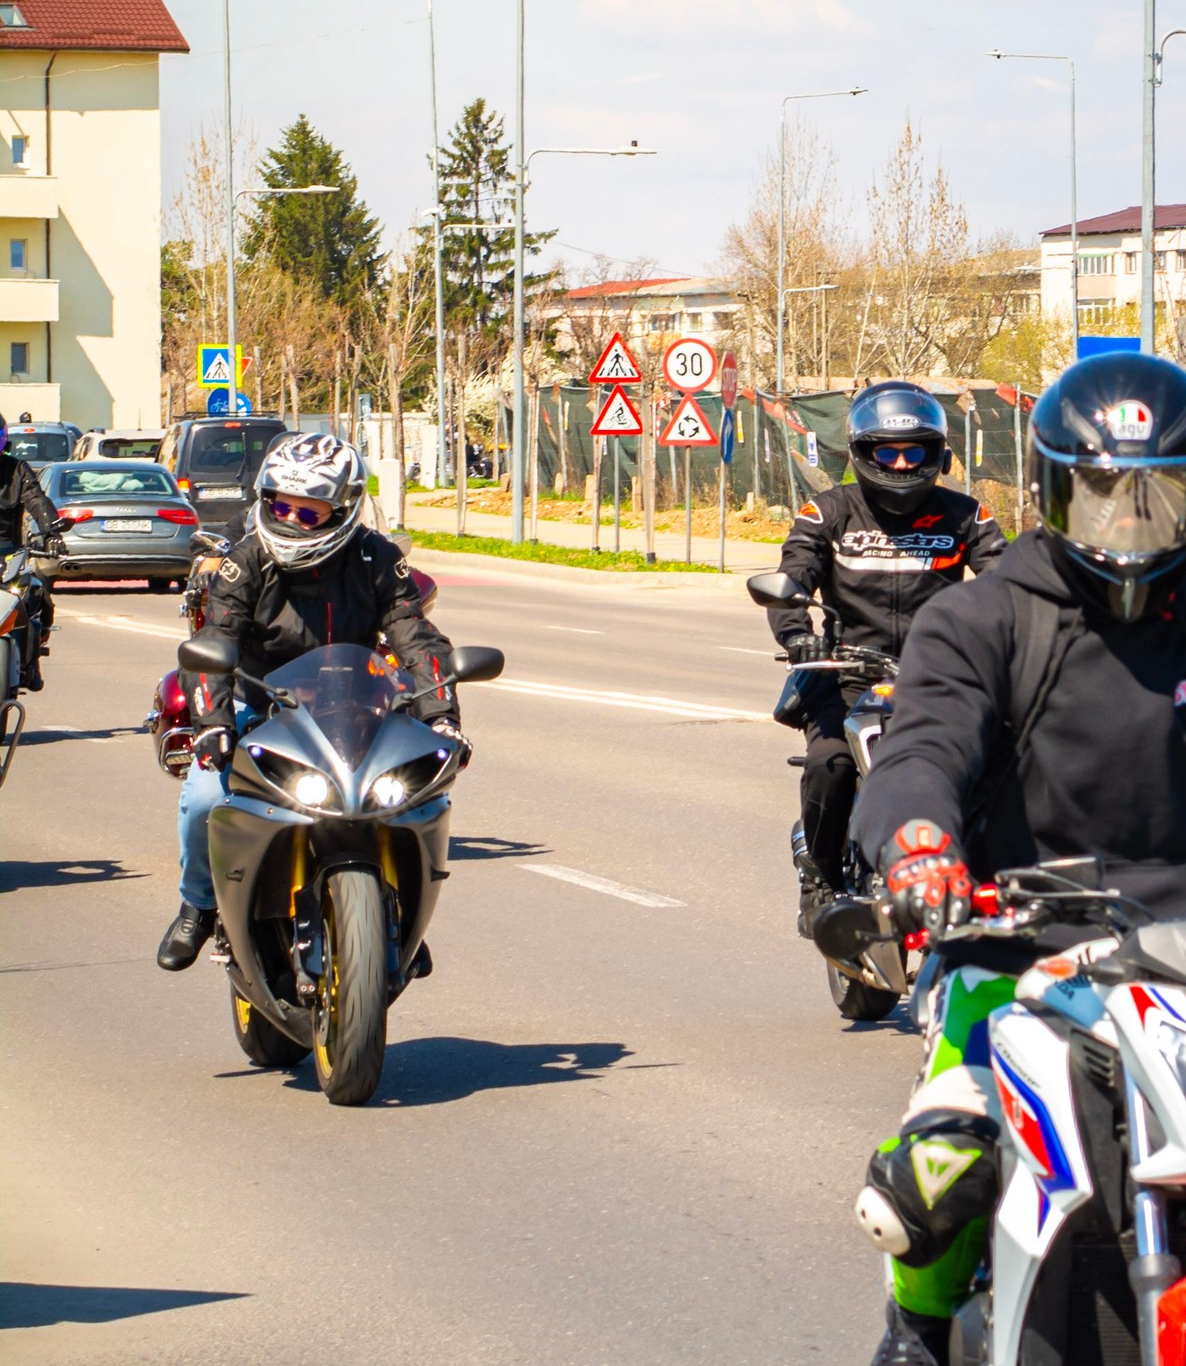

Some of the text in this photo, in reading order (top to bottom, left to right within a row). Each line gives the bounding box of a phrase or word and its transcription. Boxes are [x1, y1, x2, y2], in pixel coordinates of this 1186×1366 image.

[676, 352, 703, 376] 30
[841, 529, 955, 551] alpinestars
[900, 549, 931, 557] AHEAD
